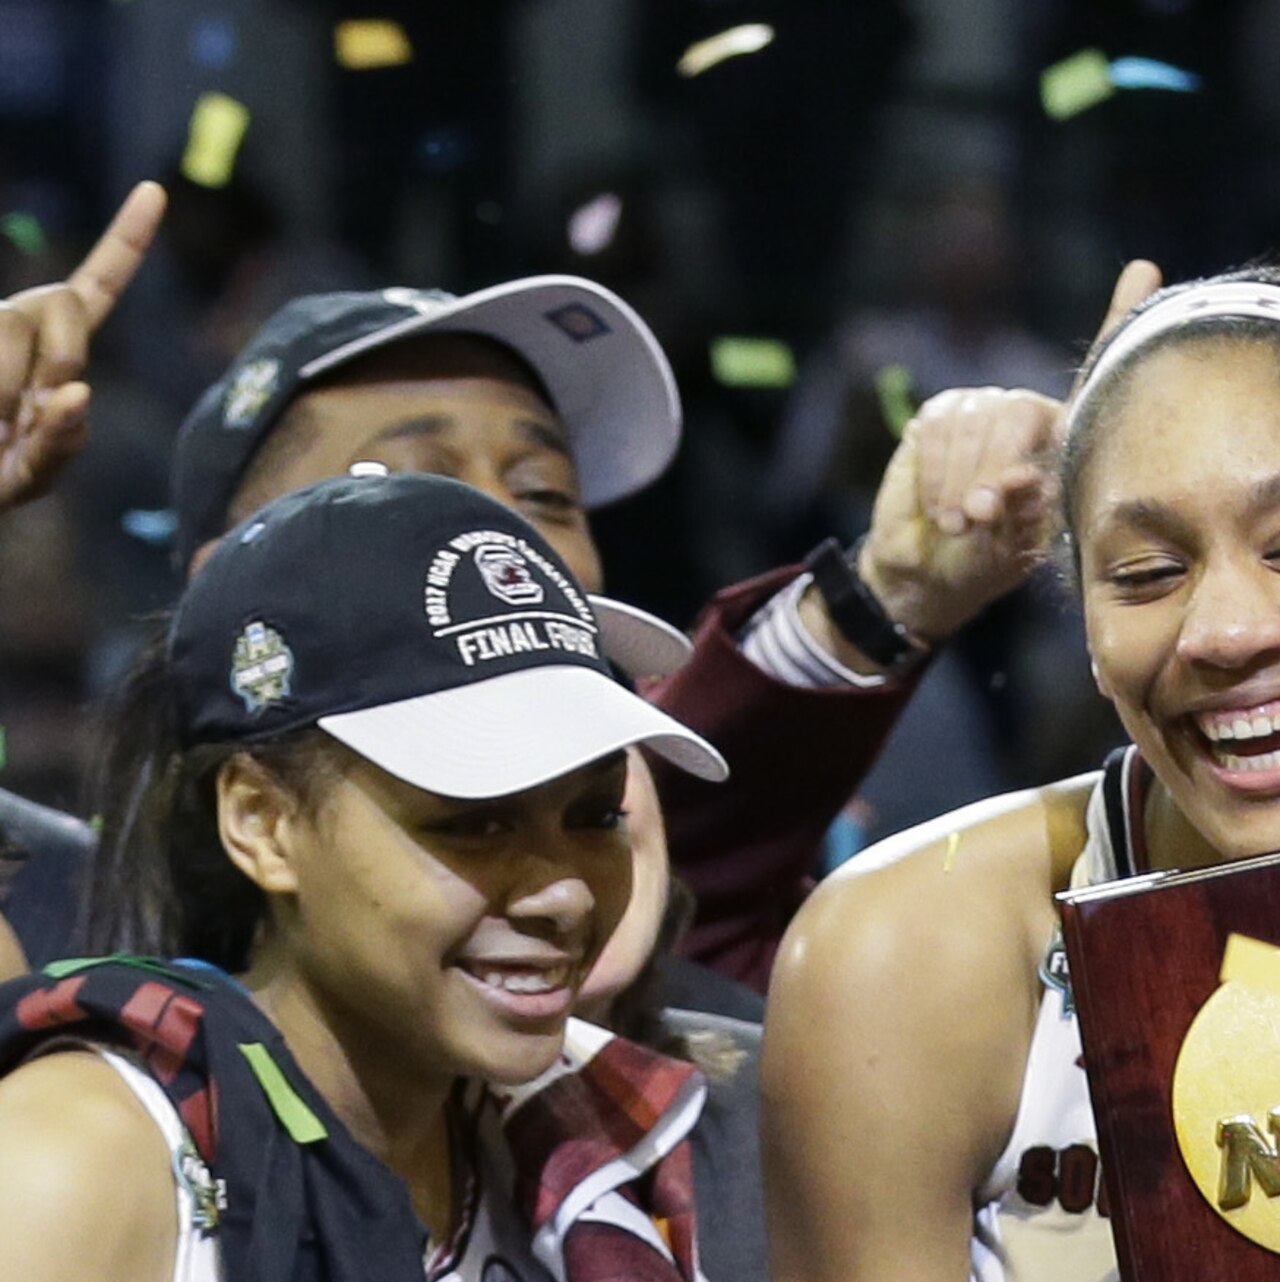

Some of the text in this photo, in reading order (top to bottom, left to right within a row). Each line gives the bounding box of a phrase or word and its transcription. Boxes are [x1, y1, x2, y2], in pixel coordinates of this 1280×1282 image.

[427, 550, 460, 586] NCAA
[425, 586, 451, 626] 2017
[457, 621, 549, 666] FINAL
